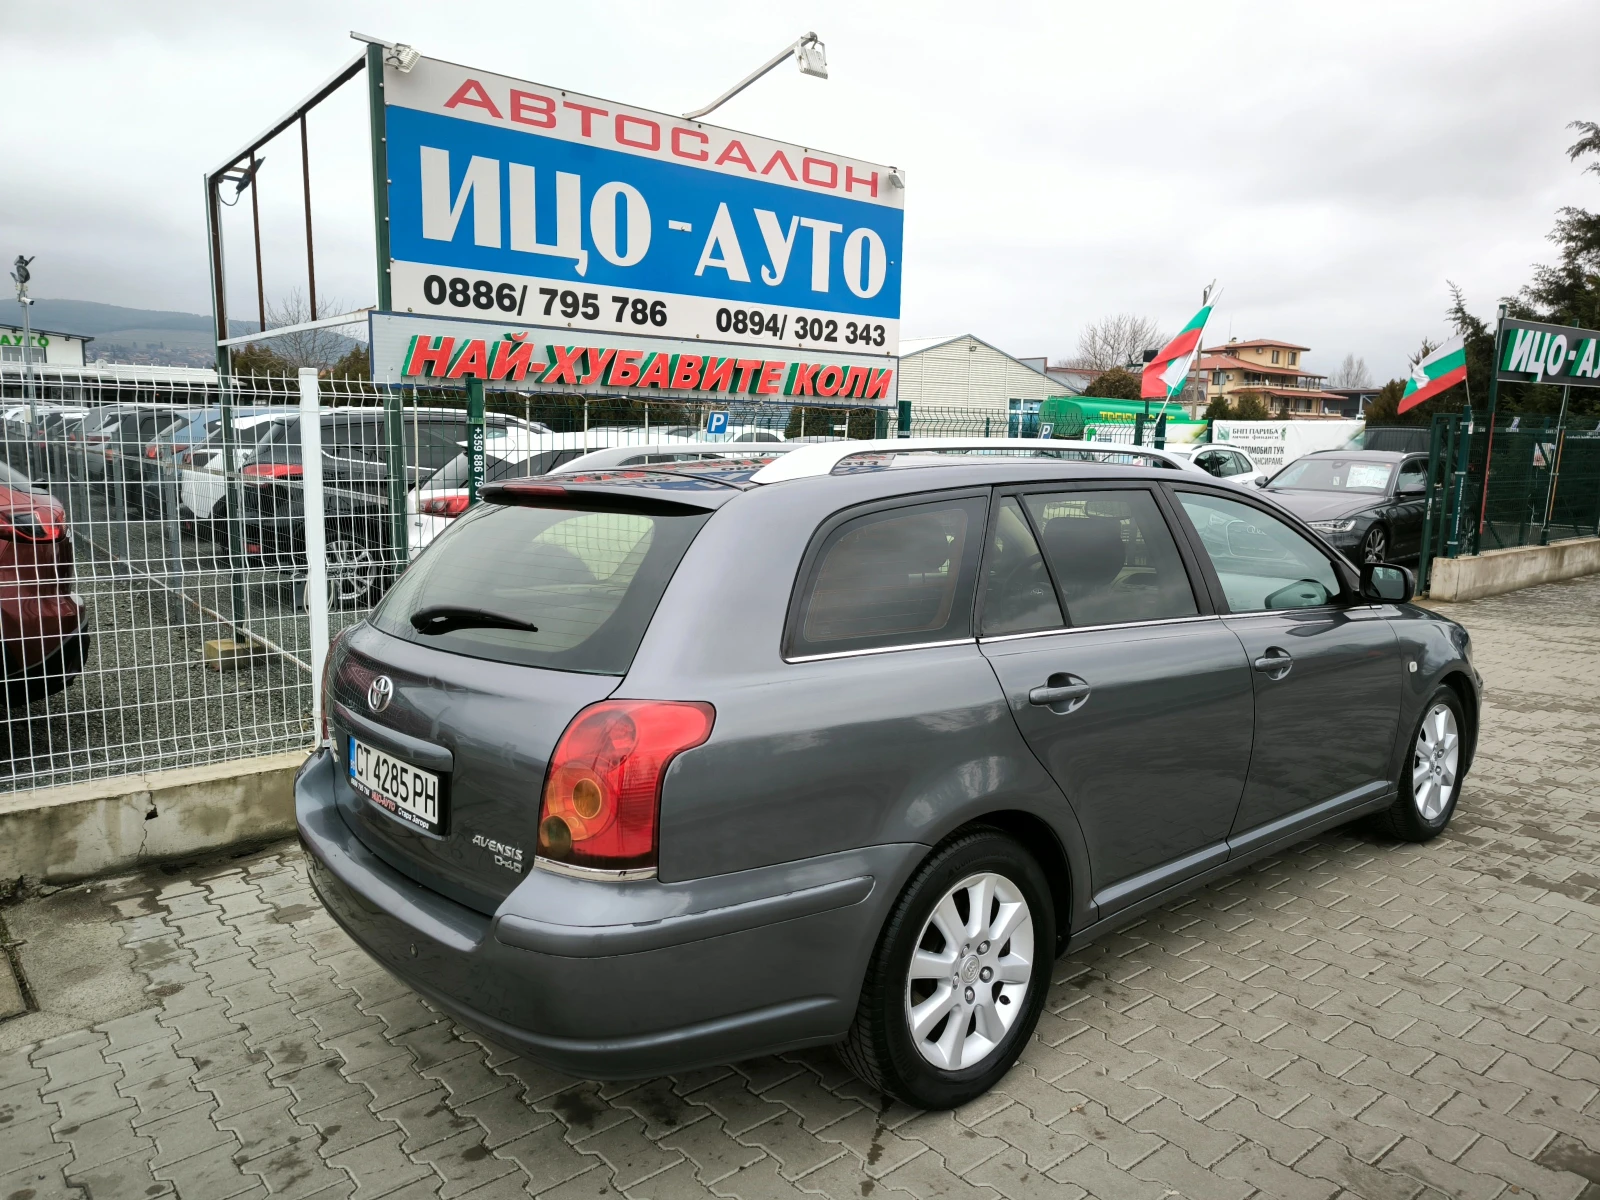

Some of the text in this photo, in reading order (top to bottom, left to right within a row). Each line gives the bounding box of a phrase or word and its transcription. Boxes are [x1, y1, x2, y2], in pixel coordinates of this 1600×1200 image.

[444, 78, 878, 198] АВТОСАЛОН
[538, 287, 600, 320] 795
[611, 295, 668, 327] 786
[794, 316, 838, 342] 302
[845, 322, 886, 347] 343
[403, 331, 893, 399] НАЙ-ХУБАВИТЕ КОЛИ
[711, 413, 725, 432] P
[473, 426, 483, 452] +359
[1273, 446, 1285, 455] ТУК
[473, 454, 484, 473] 886
[474, 475, 484, 488] 79
[356, 743, 436, 817] CT 4285 PH
[397, 807, 411, 821] Стара
[412, 815, 429, 830] Загора
[472, 834, 523, 862] AVENSIS
